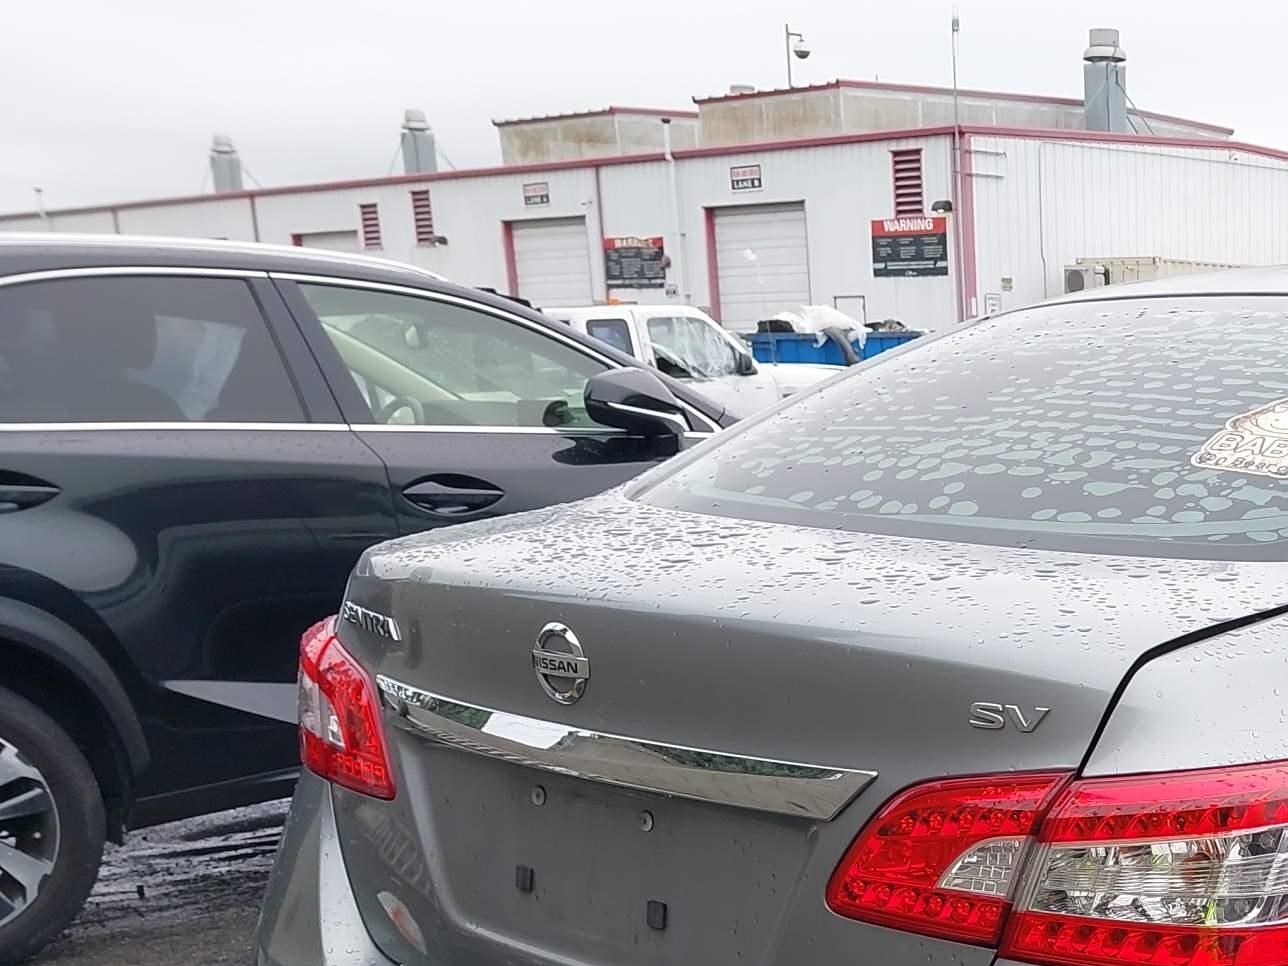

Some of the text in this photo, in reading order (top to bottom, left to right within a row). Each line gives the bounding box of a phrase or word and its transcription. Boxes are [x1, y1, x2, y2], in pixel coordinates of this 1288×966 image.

[883, 218, 934, 232] WARNING
[343, 600, 402, 641] SENTRA
[532, 654, 579, 675] NISSAN
[968, 702, 1051, 733] SV
